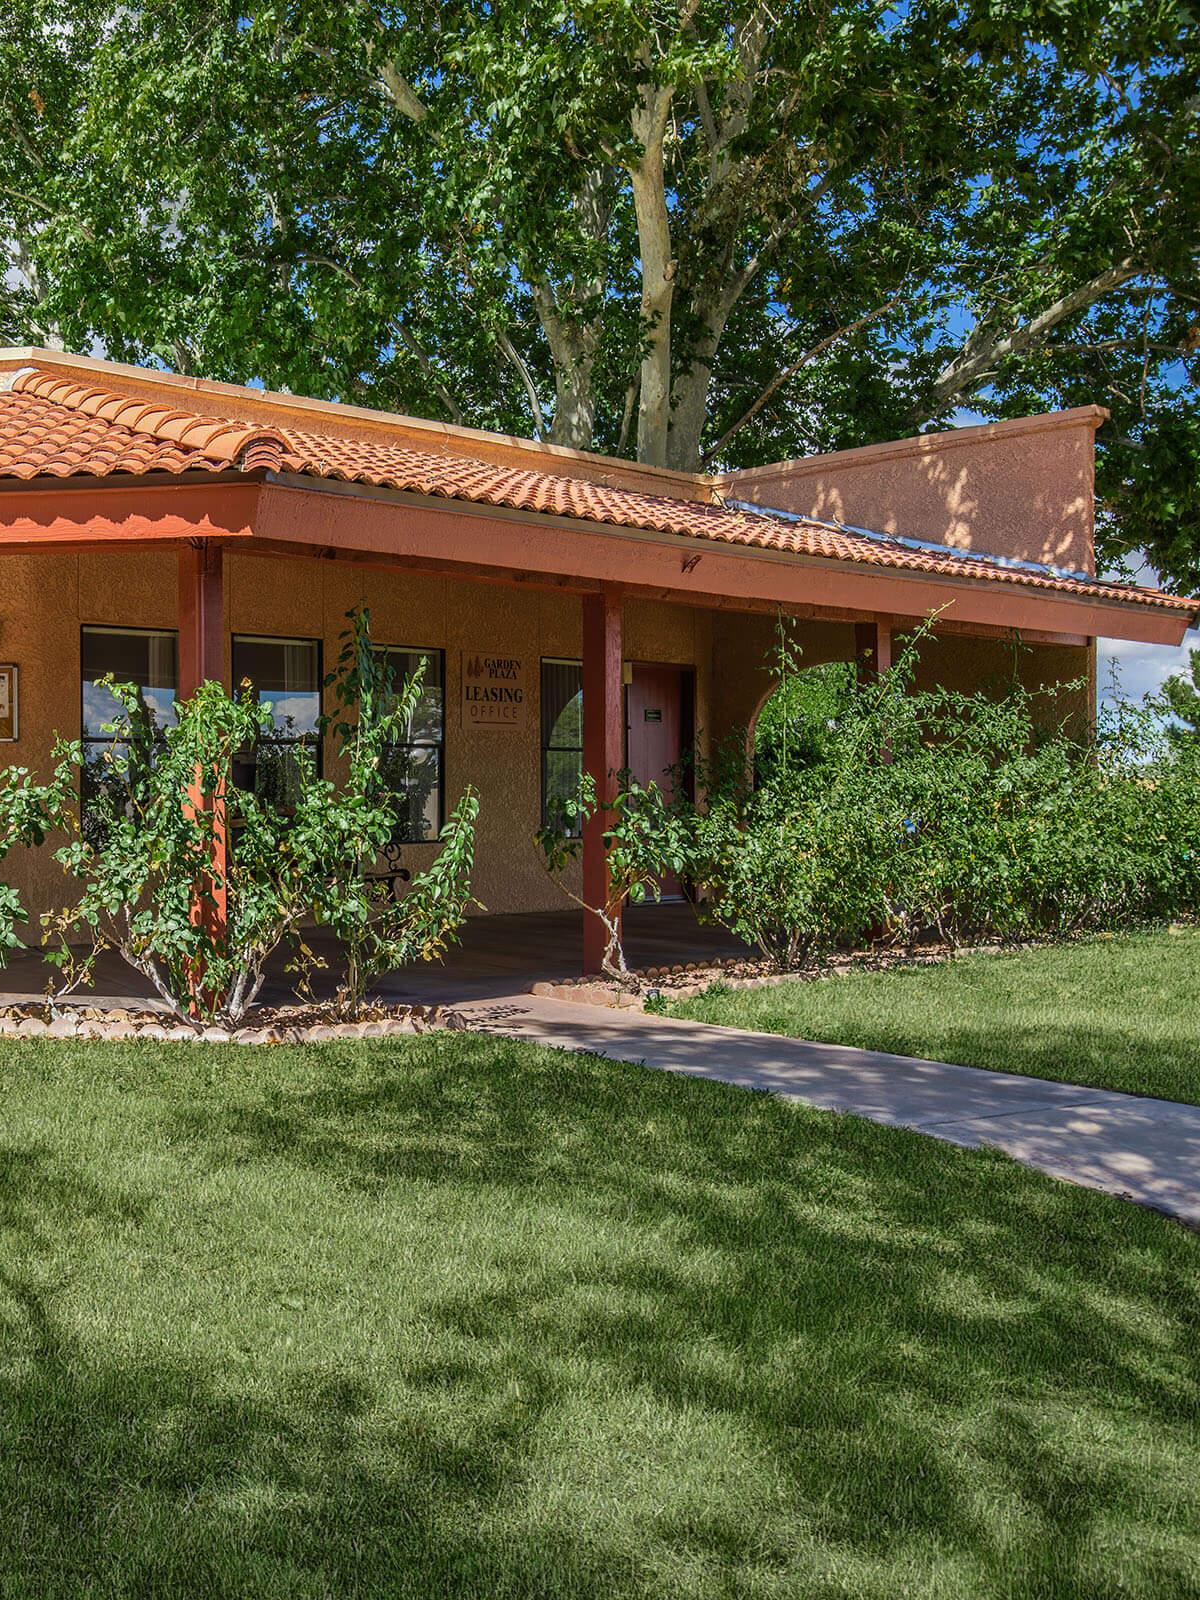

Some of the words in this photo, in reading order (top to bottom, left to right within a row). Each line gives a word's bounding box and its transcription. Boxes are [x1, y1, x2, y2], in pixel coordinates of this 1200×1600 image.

[484, 658, 521, 670] GARDEN
[489, 668, 517, 680] PLAZA
[466, 686, 522, 703] LEASING
[470, 705, 518, 718] OFFICE
